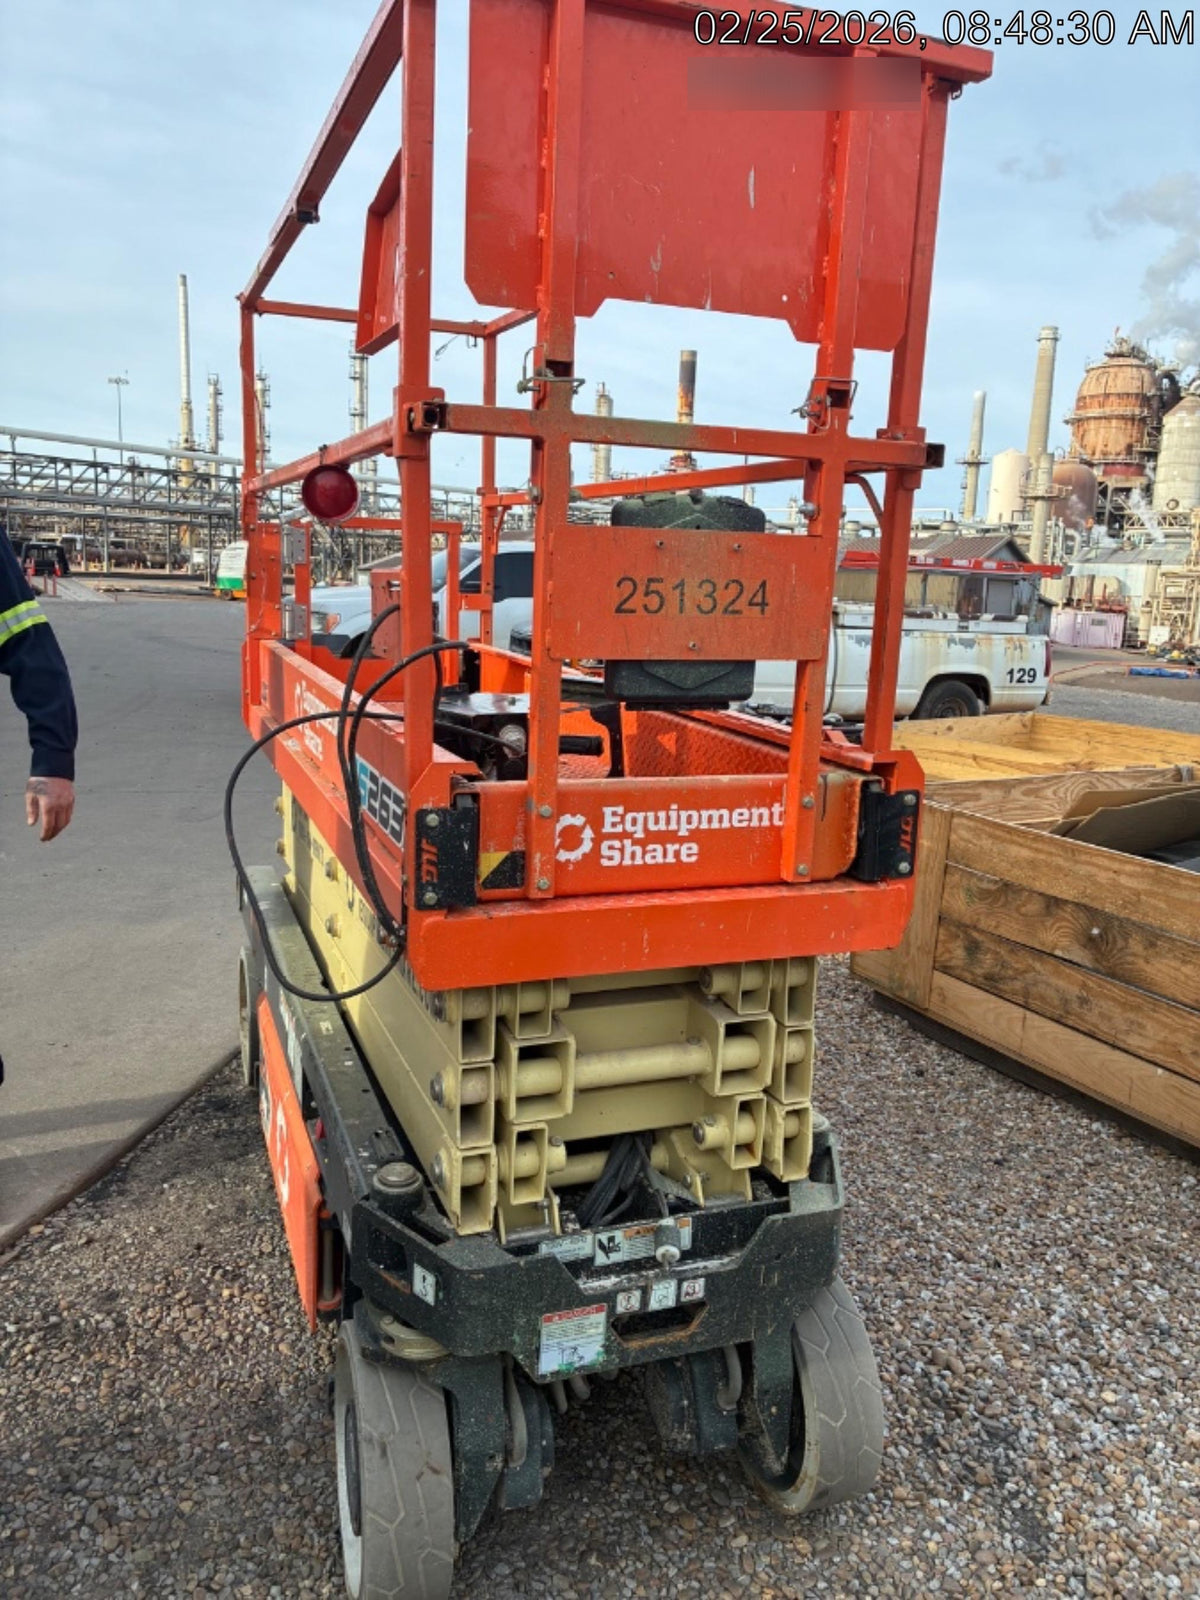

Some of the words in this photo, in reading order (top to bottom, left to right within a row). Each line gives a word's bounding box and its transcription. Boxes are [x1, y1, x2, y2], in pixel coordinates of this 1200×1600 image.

[616, 577, 769, 614] 251324
[1007, 668, 1037, 684] 129
[602, 804, 784, 836] Equipment
[421, 838, 438, 883] JLG
[600, 841, 699, 866] Share
